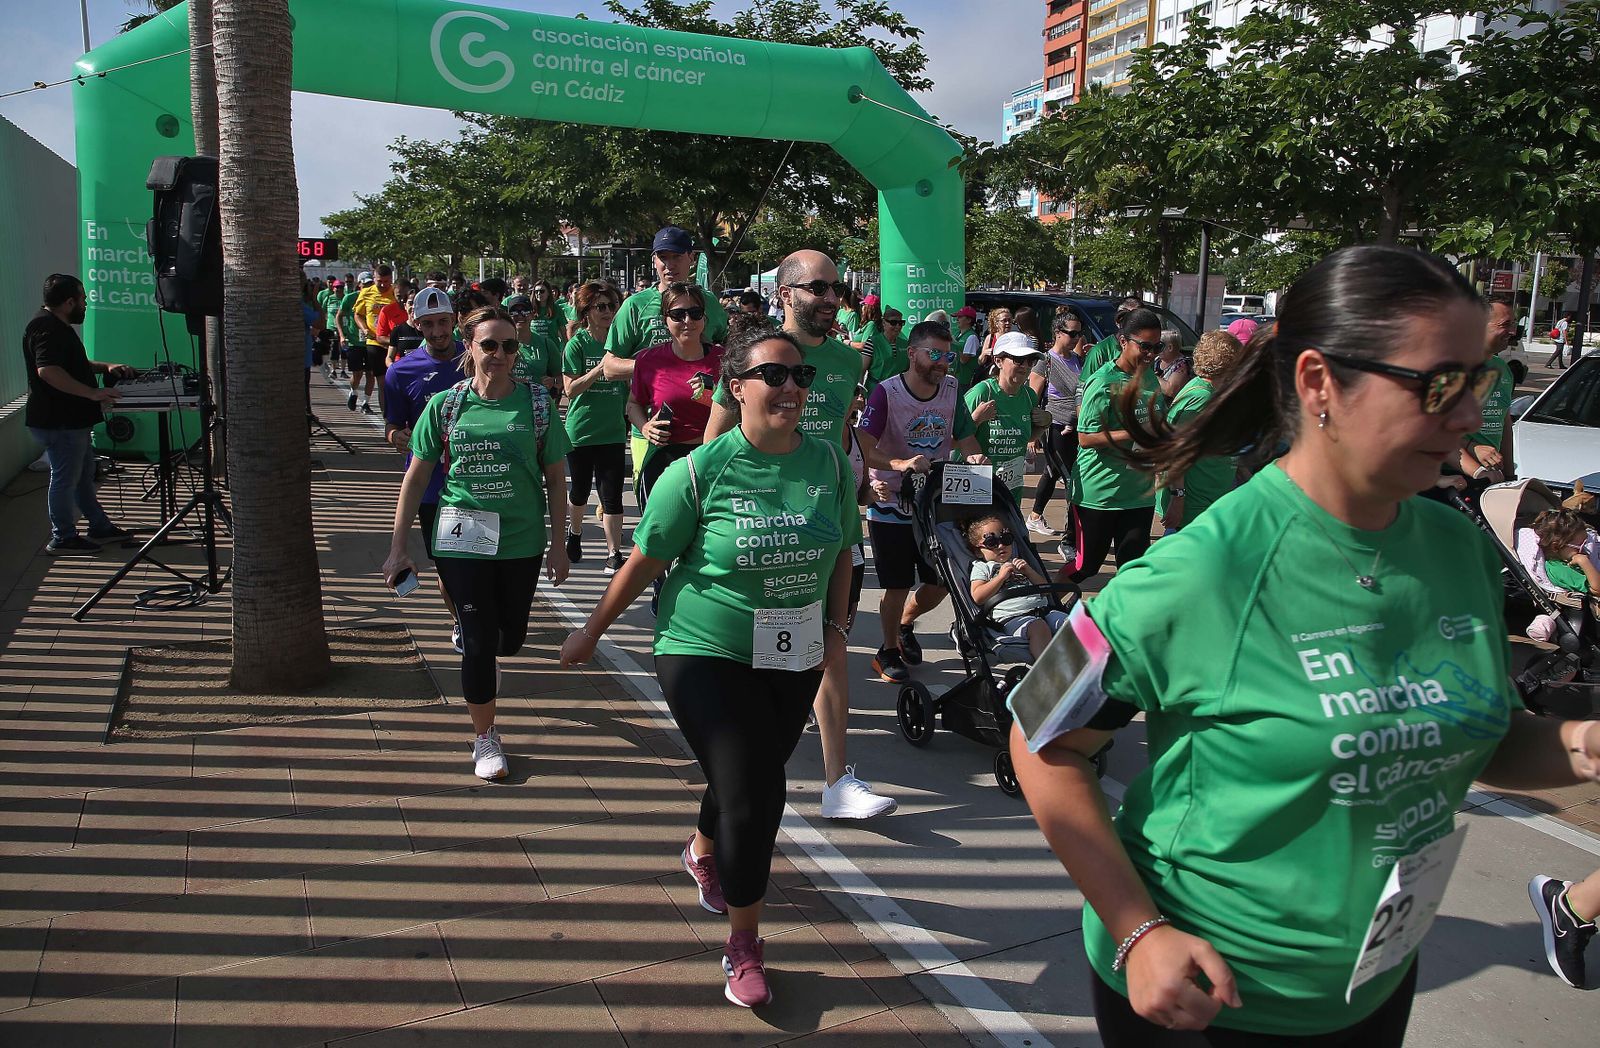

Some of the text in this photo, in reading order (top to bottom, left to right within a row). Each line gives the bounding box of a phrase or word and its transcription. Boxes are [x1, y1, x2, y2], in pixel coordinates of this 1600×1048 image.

[532, 28, 747, 66] asociación española
[532, 53, 706, 86] contra el cáncer
[530, 79, 625, 103] en Cádiz
[87, 222, 108, 240] En
[88, 246, 153, 264] march
[297, 241, 324, 256] 68
[88, 267, 155, 285] contra
[906, 265, 926, 278] En
[89, 285, 158, 305] el cánc
[907, 280, 960, 294] marcha
[907, 296, 954, 310] contra
[908, 312, 921, 325] el
[806, 390, 826, 403] cha
[801, 405, 818, 416] tra
[798, 419, 833, 430] áncer
[989, 426, 1021, 436] marcha
[452, 430, 466, 440] En
[988, 436, 1016, 445] contra
[453, 440, 501, 452] marcha
[457, 452, 494, 464] ontra
[454, 462, 512, 474] el cáncer
[945, 478, 970, 493] 279
[731, 497, 757, 513] En
[735, 512, 808, 530] marcha
[450, 522, 463, 538] 4
[735, 531, 800, 549] contra
[736, 551, 756, 567] el
[761, 548, 825, 566] cáncer
[776, 630, 792, 653] 8
[1298, 648, 1354, 681] En
[1318, 675, 1448, 718] marcha
[1330, 718, 1442, 759] contra
[1328, 749, 1476, 794] el cáncer
